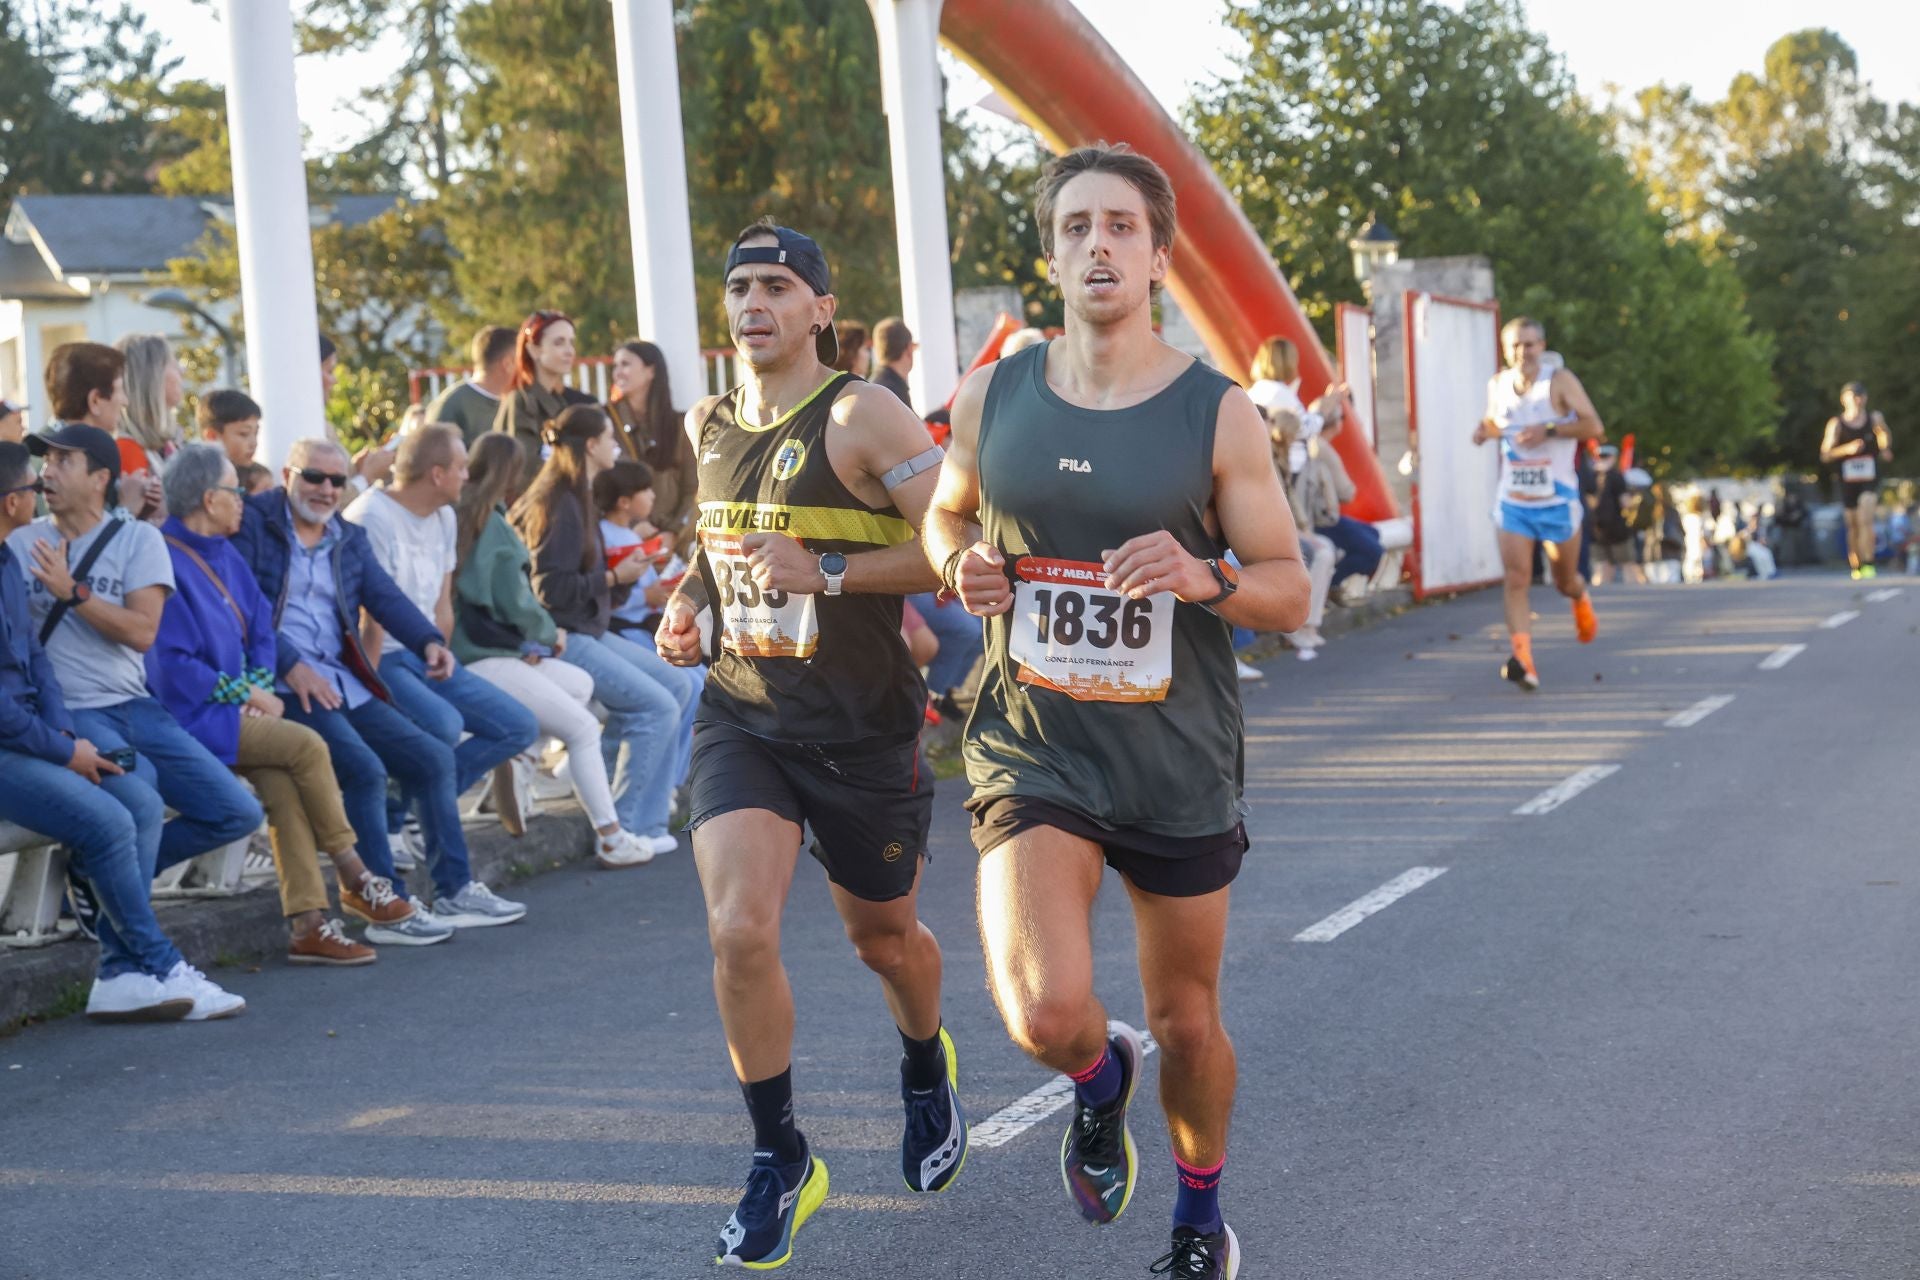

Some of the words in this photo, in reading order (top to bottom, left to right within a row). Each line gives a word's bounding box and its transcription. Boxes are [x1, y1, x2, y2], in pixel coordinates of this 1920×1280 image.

[1059, 458, 1092, 473] FILA
[1062, 568, 1095, 581] MBA
[1035, 589, 1153, 649] 1836
[1044, 655, 1084, 665] GONZALO
[1085, 657, 1135, 667] FERNÁNDEZ
